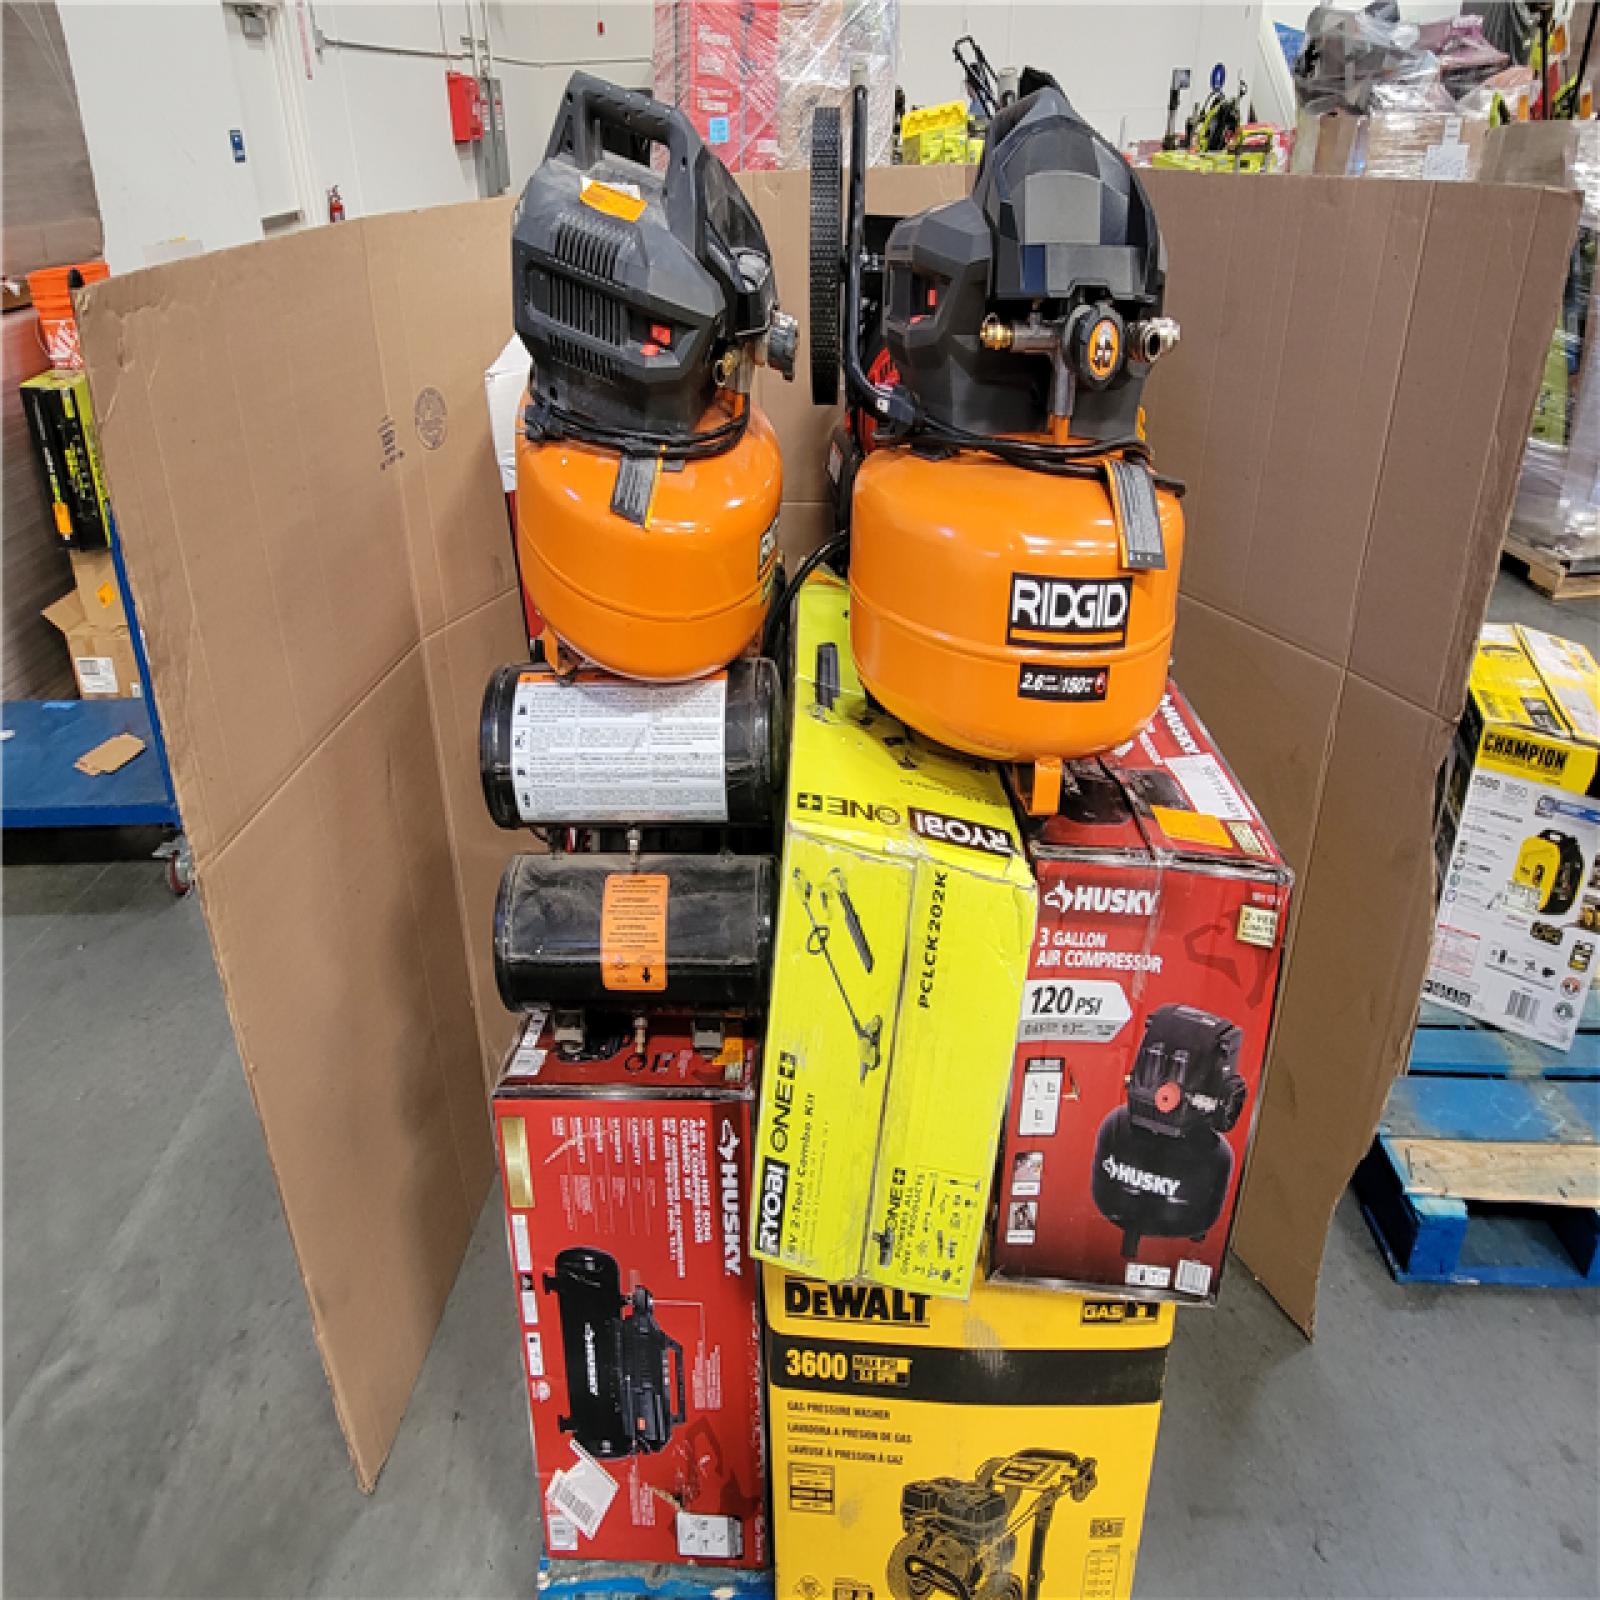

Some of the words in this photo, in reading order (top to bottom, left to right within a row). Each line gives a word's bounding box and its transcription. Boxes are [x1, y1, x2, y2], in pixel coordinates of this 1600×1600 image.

[1012, 580, 1127, 628] RIDGID
[1484, 731, 1568, 770] CHAMPION
[915, 812, 1009, 854] RYOBI
[1074, 884, 1160, 916] HUSKY
[918, 872, 949, 1008] PCLCK202K
[1038, 927, 1050, 948] 3
[1053, 931, 1107, 949] GALLON
[1036, 949, 1060, 968] AIR
[1064, 951, 1162, 974] COMPRESSOR
[1031, 985, 1073, 1016] 120
[1075, 997, 1103, 1016] PSI
[796, 1121, 811, 1177] Combo
[804, 1092, 814, 1117] Kit
[690, 1149, 702, 1243] COMPRESSOR
[1117, 1164, 1181, 1195] HUSKY
[721, 1162, 741, 1275] HUSKY
[760, 1161, 786, 1255] RYOBI
[1083, 1303, 1124, 1320] GAS
[786, 1347, 848, 1381] 3600
[788, 1401, 805, 1412] GAS
[807, 1402, 851, 1416] PRESSURE
[853, 1407, 890, 1420] WASHER
[834, 1449, 876, 1463] PRESSION
